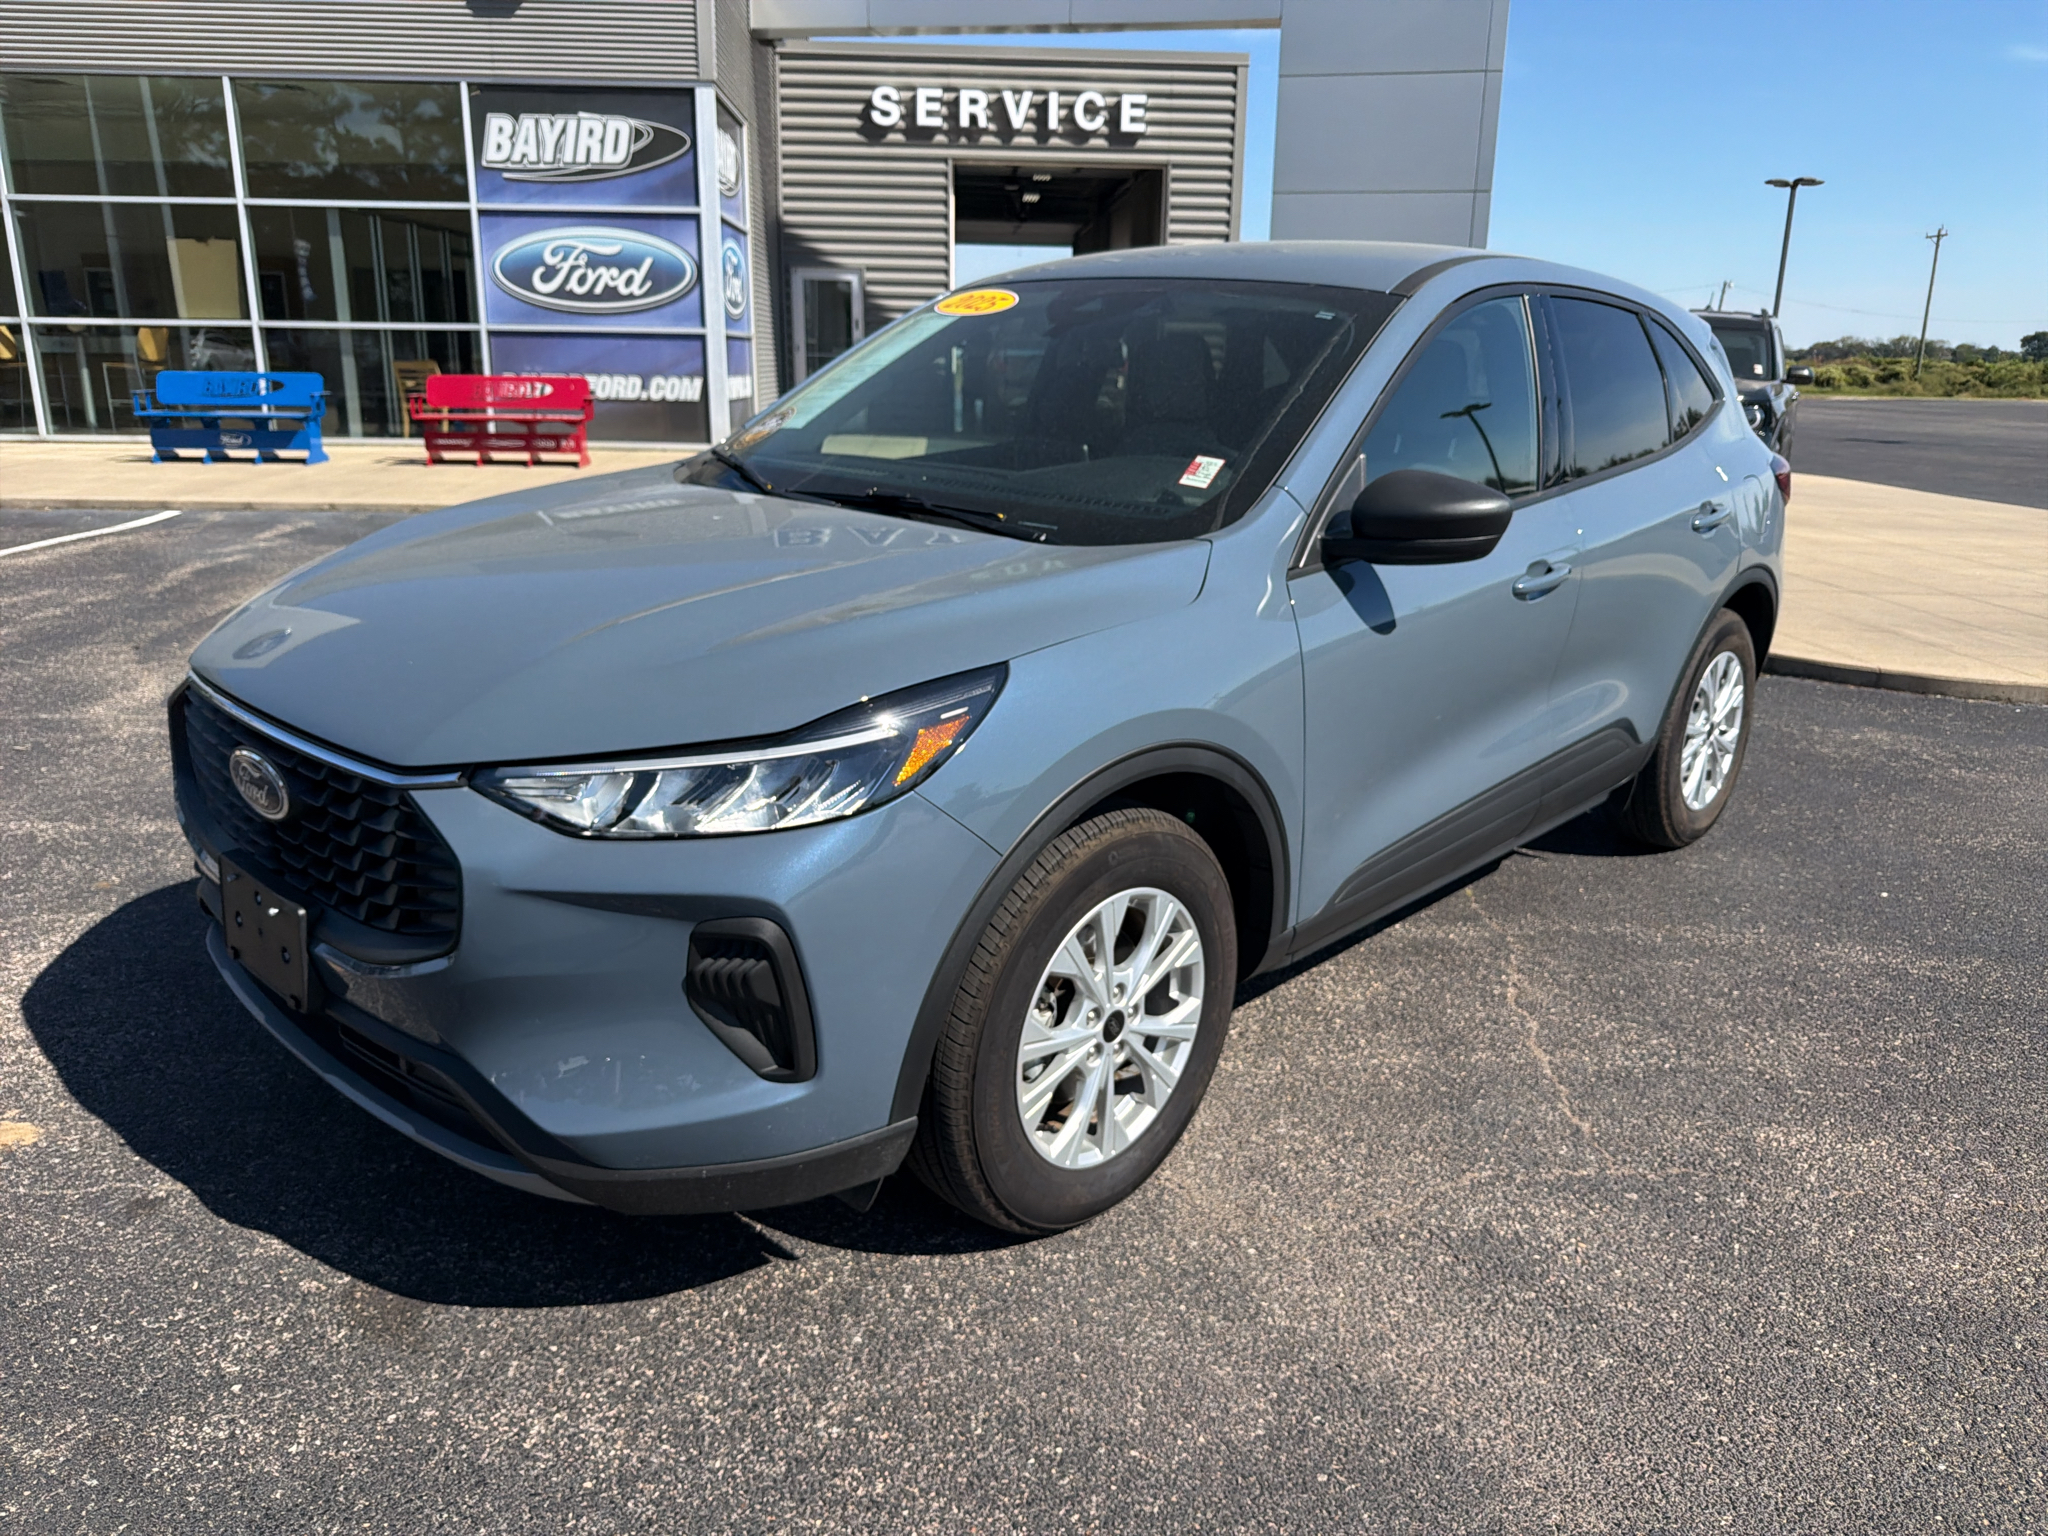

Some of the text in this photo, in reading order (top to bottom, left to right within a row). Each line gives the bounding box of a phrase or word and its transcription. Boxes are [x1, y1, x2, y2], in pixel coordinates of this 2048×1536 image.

[869, 85, 1149, 133] SERVICE
[483, 113, 634, 168] BAYIRD
[532, 241, 655, 297] Ford
[236, 762, 269, 806] Ford
